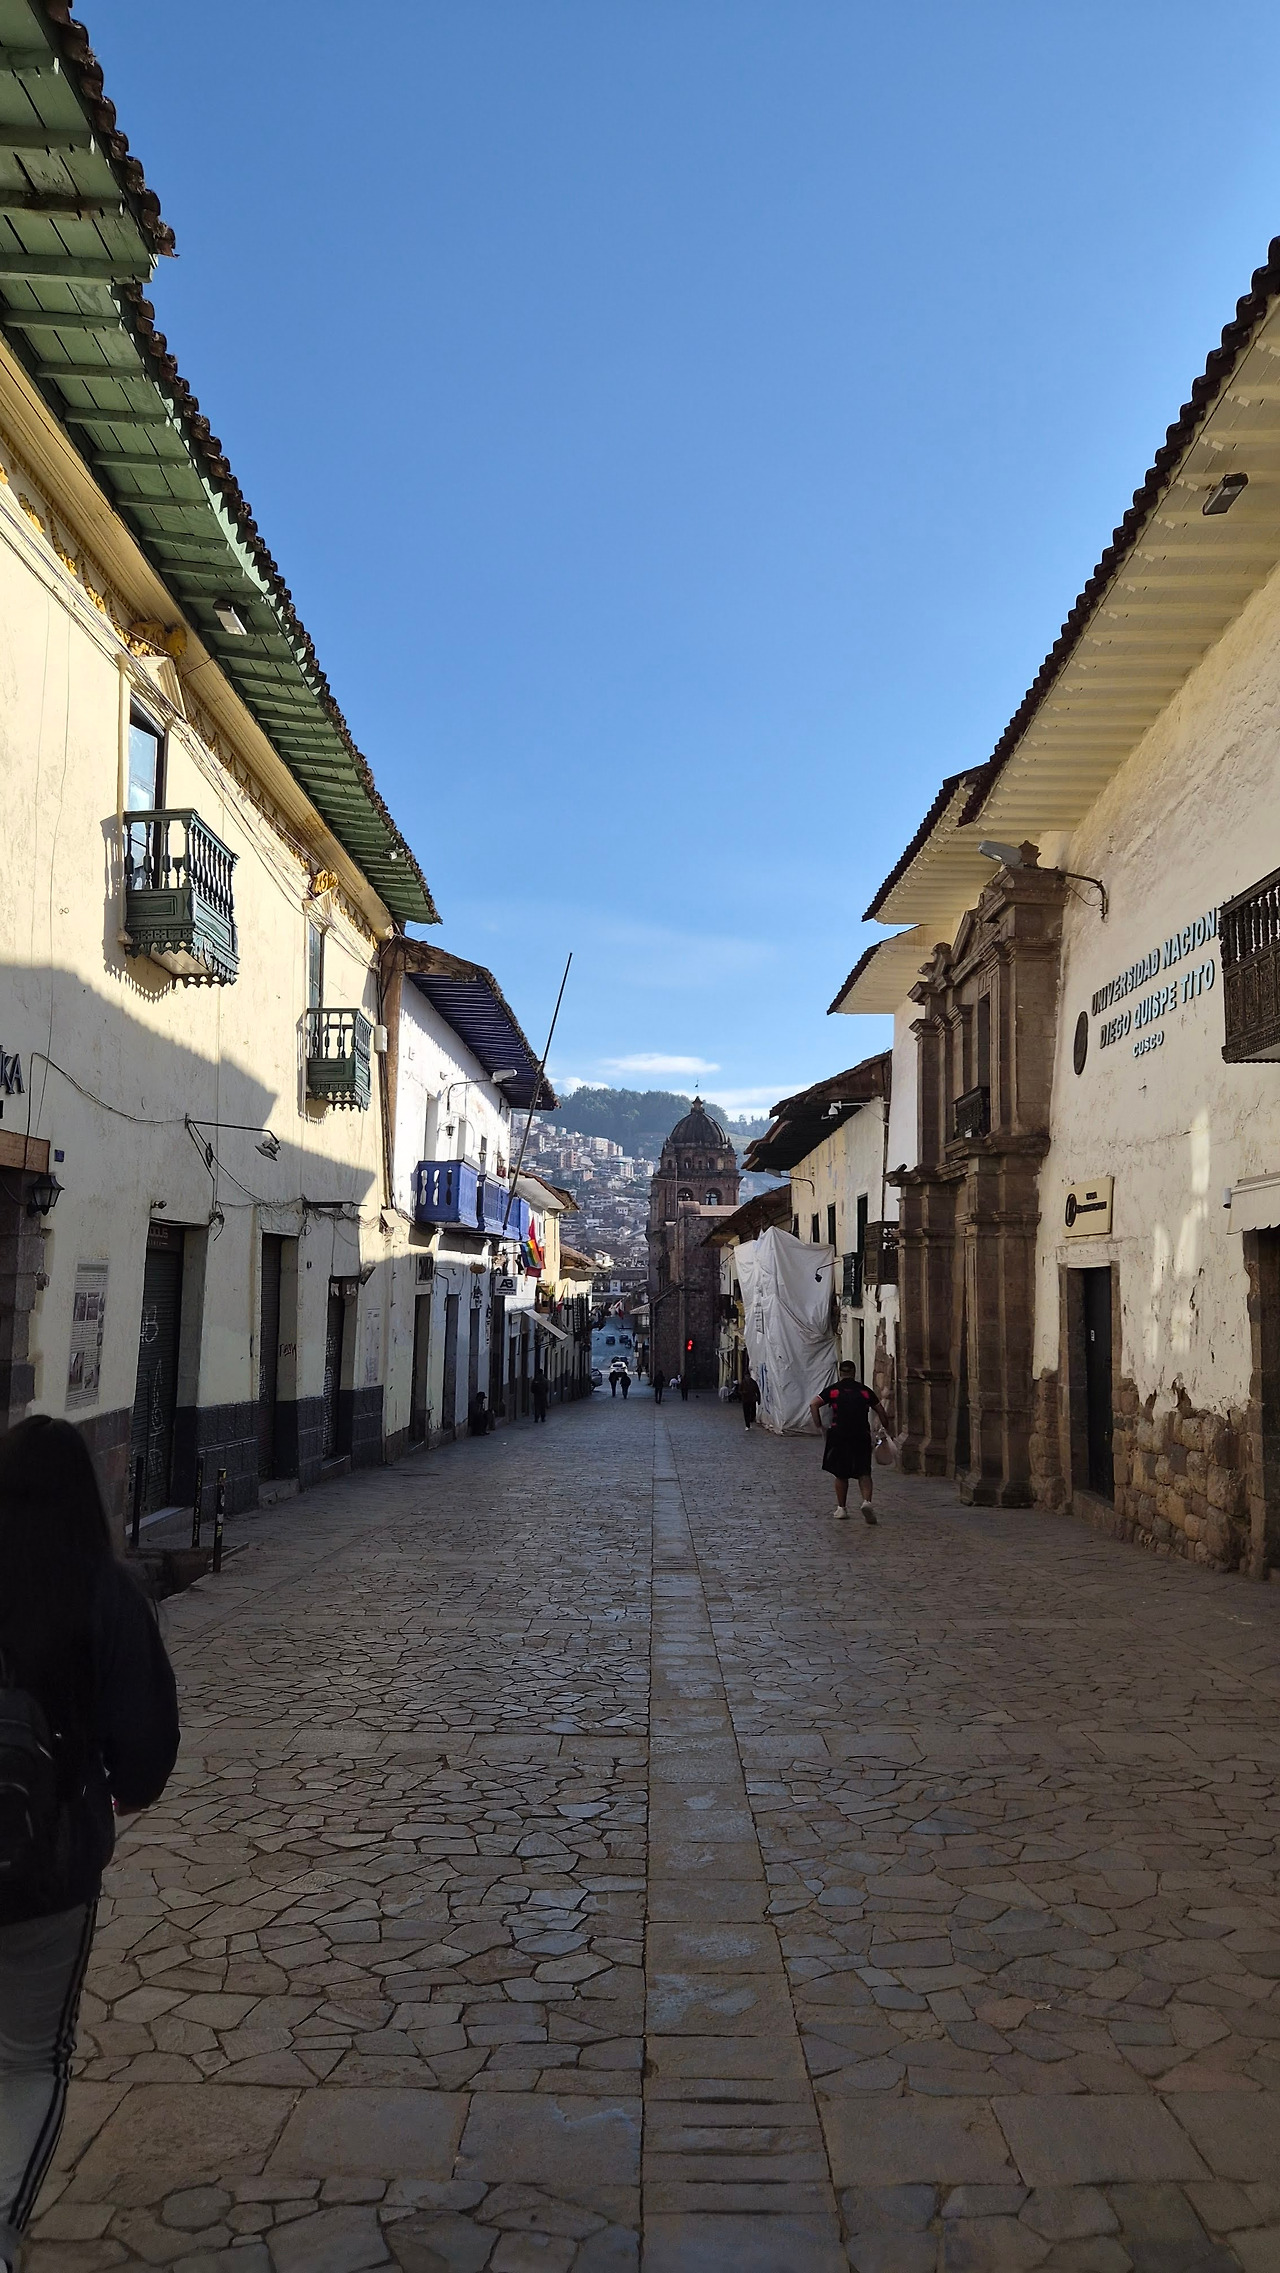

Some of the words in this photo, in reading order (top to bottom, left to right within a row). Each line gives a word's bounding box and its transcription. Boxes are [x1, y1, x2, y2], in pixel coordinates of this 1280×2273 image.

[1091, 948, 1160, 1016] UNIVERSIDAD
[1162, 907, 1219, 969] NACION
[1099, 1010, 1132, 1049] DIEGO
[1133, 980, 1177, 1030] QUISPE
[1180, 958, 1216, 1003] TITO
[0, 1046, 25, 1094] KA
[1132, 1030, 1165, 1058] CUSCO
